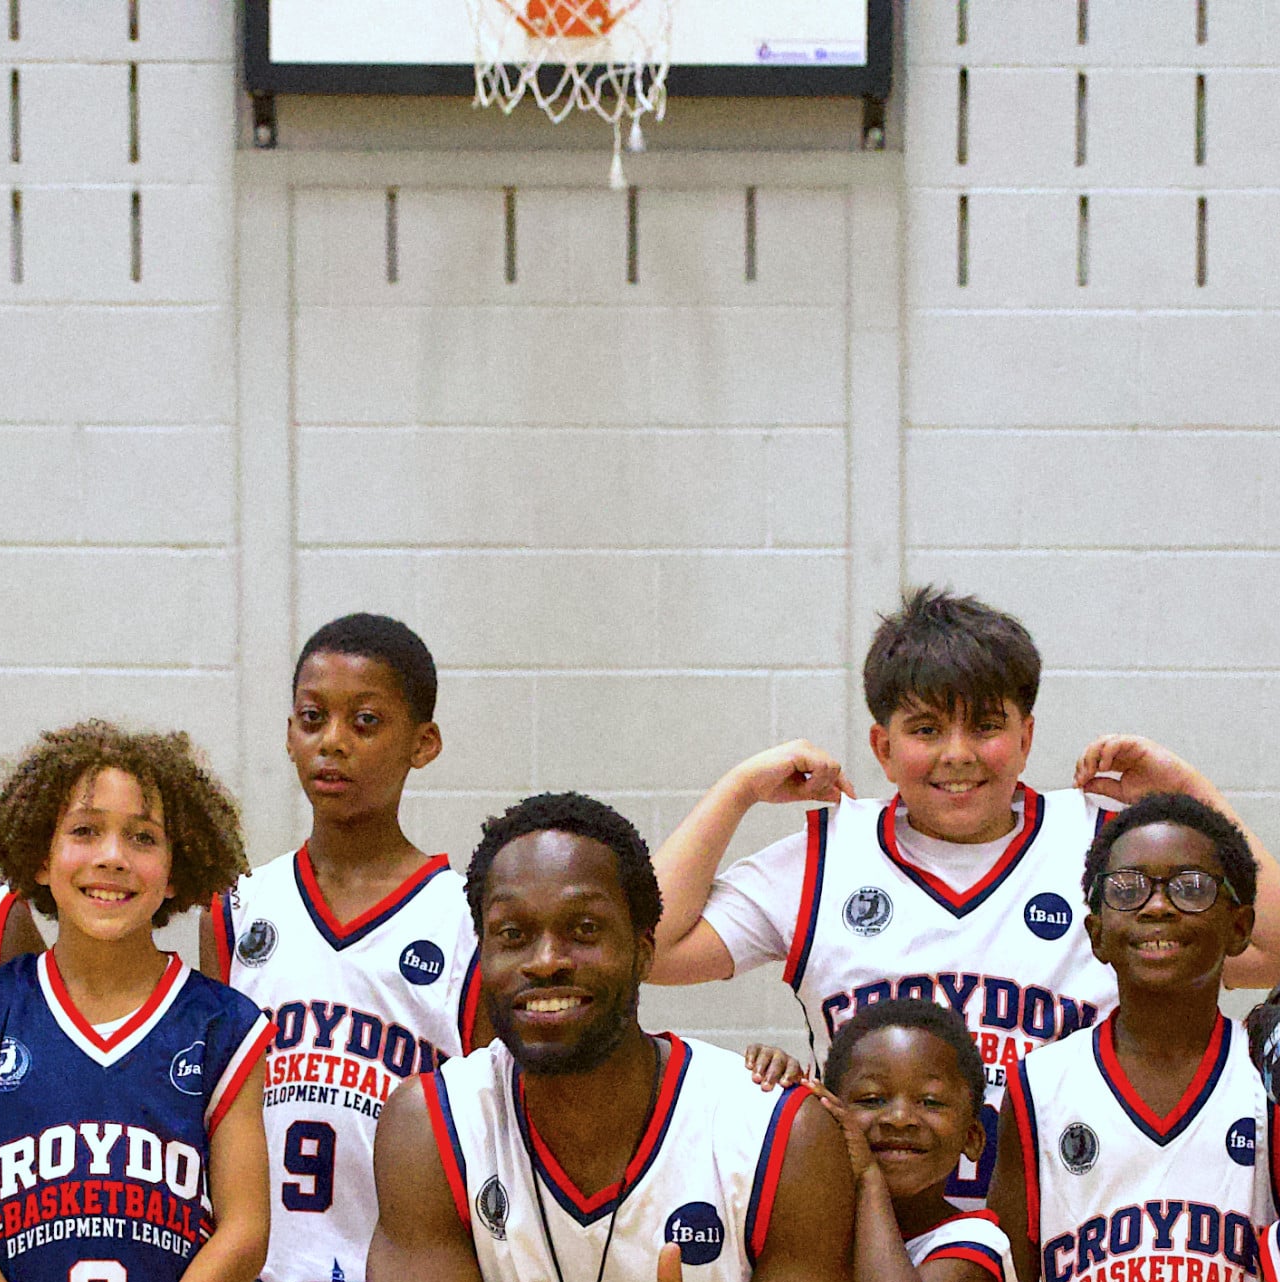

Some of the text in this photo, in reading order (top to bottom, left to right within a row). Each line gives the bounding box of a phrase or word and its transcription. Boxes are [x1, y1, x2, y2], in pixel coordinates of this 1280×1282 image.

[1029, 904, 1069, 925] iBall
[403, 948, 440, 975] iBall
[1231, 1129, 1255, 1149] iBa
[282, 1120, 337, 1213] 9
[3, 1180, 197, 1243] BASKETBALL
[7, 1217, 192, 1259] DEVELOPMENT LEAGUE
[671, 1217, 721, 1244] iBall
